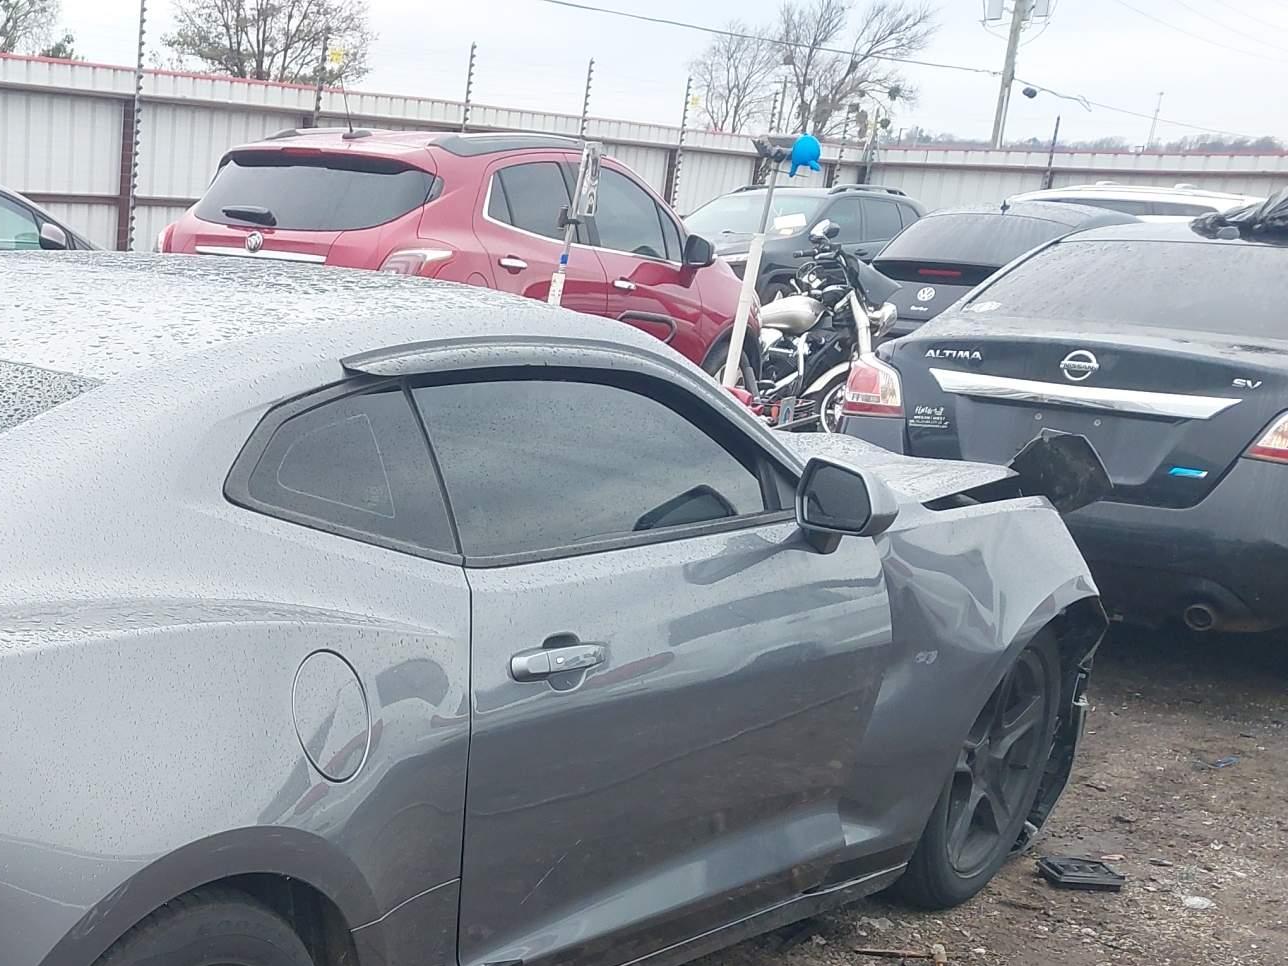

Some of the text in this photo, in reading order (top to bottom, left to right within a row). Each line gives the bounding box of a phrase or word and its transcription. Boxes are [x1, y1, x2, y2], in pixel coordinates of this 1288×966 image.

[924, 349, 982, 361] ALTIMA
[1060, 361, 1099, 370] NISSAN
[1231, 378, 1263, 389] SV
